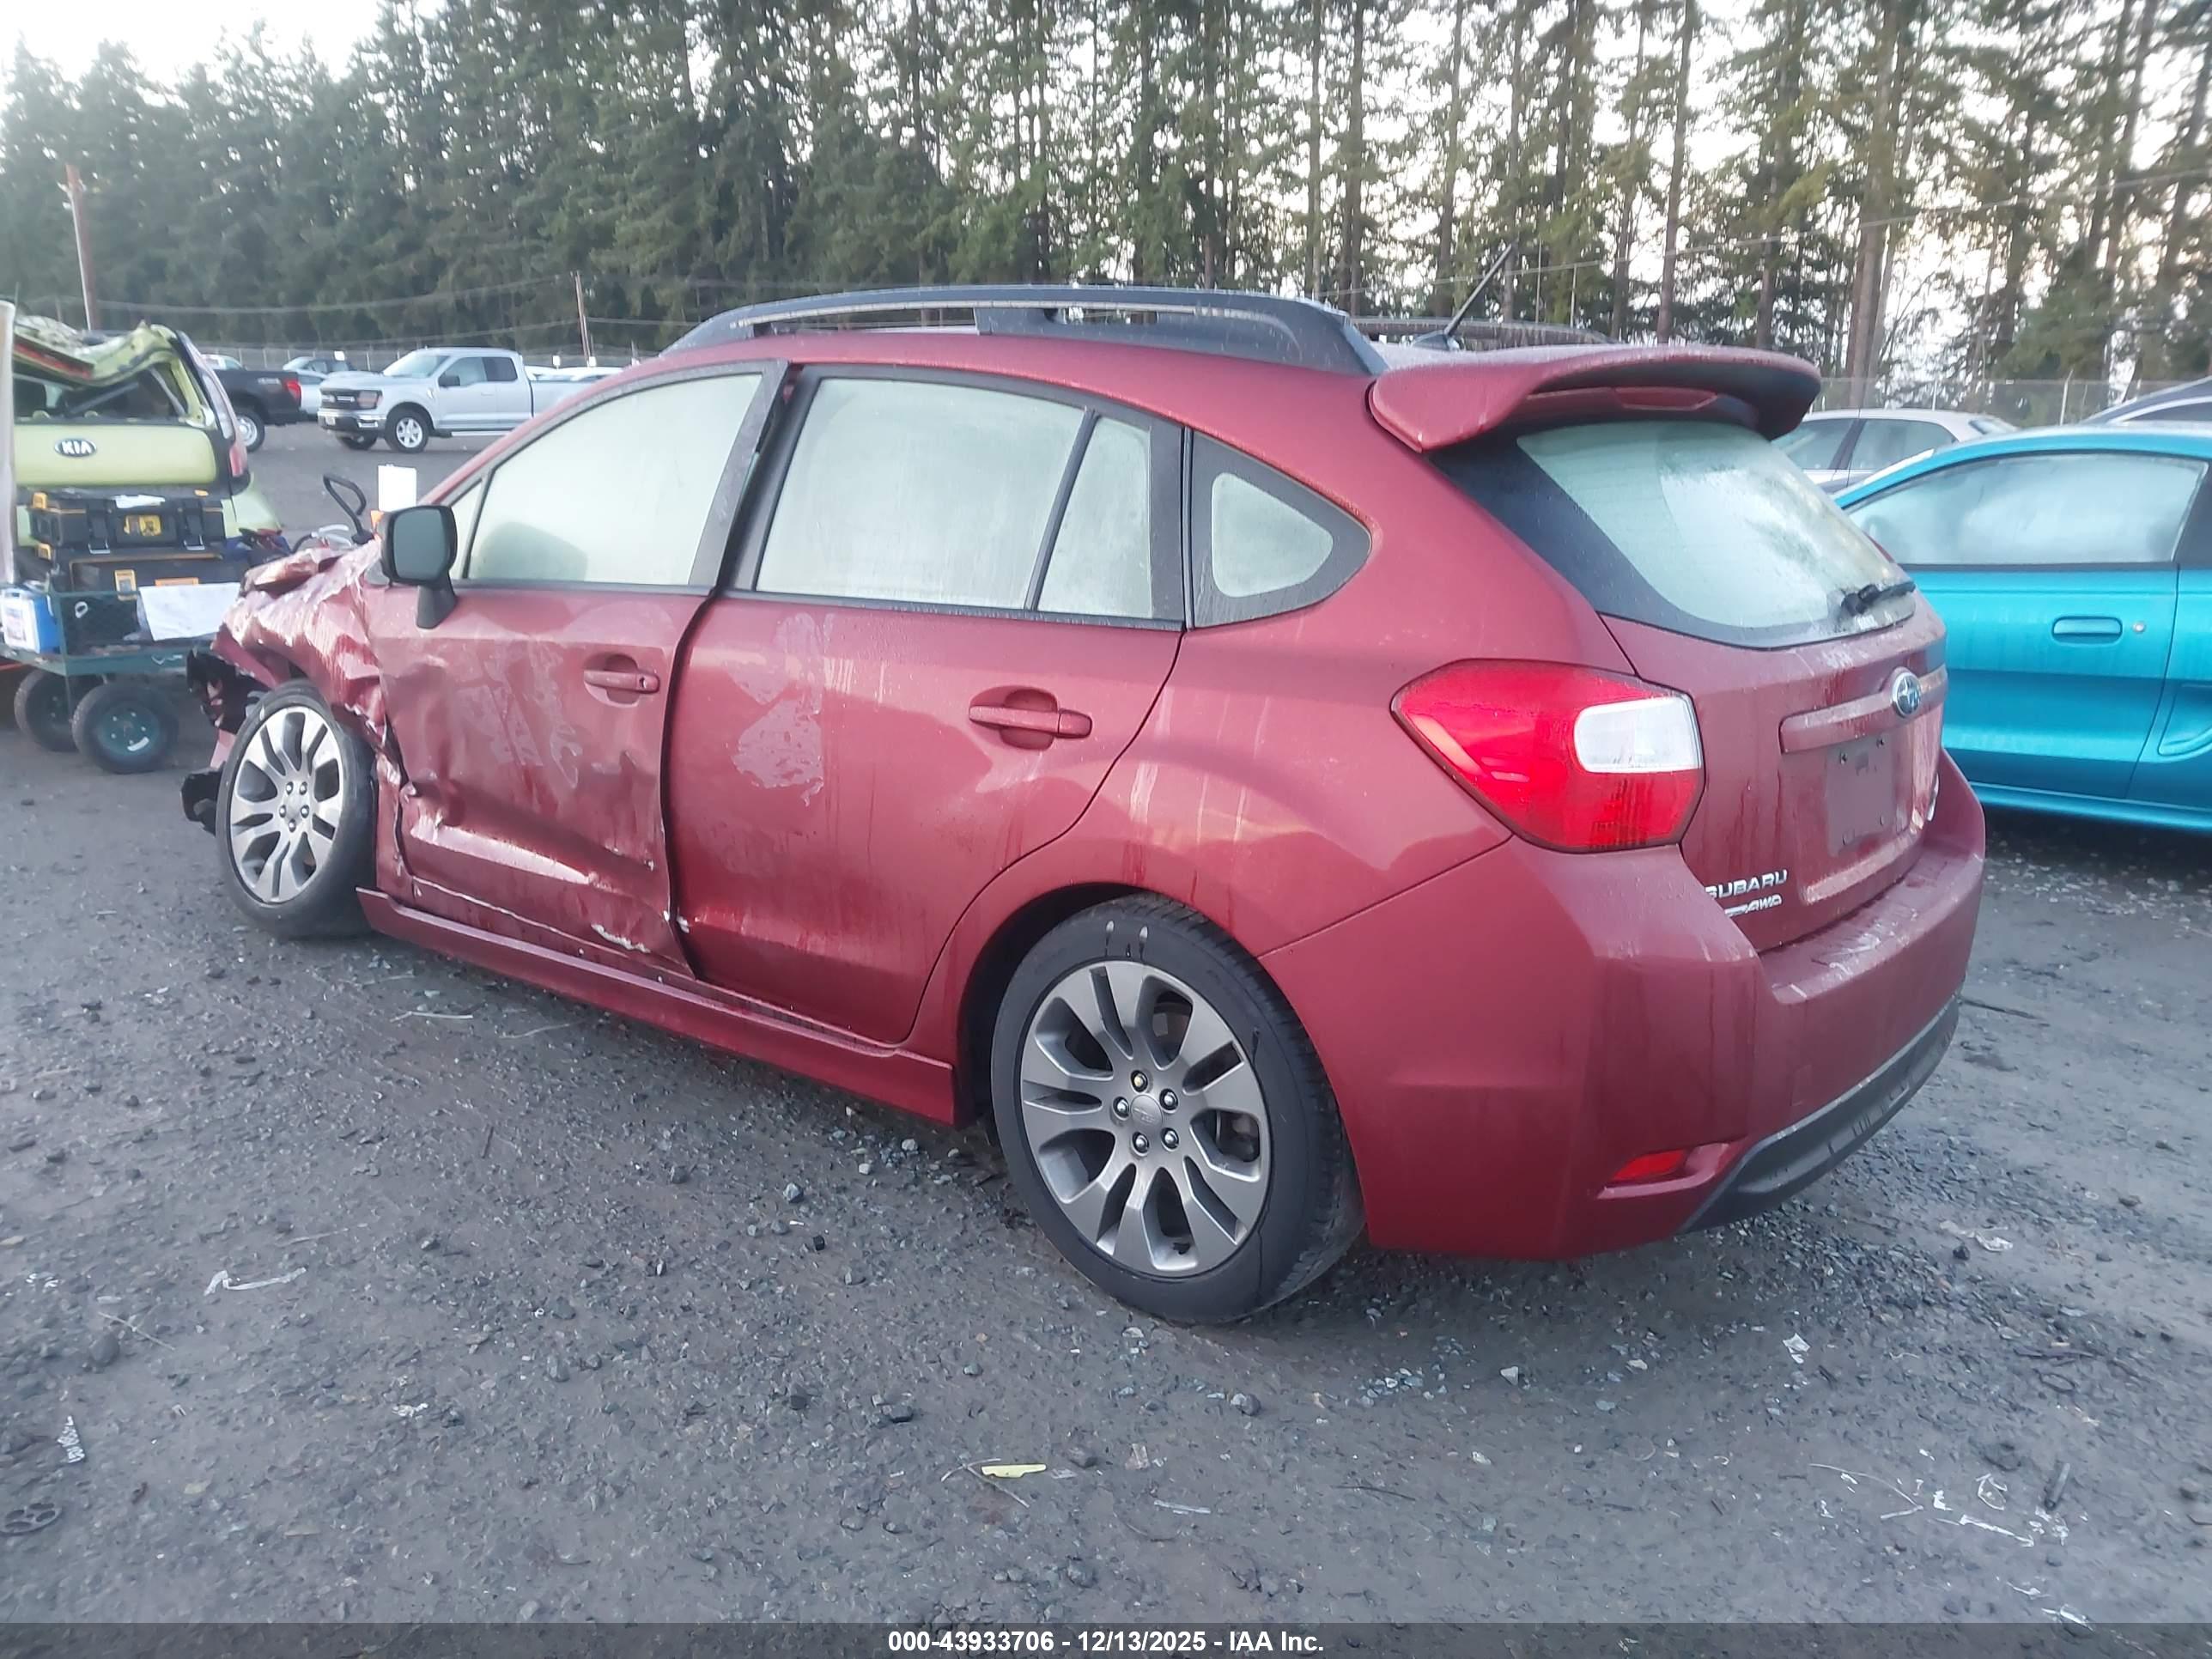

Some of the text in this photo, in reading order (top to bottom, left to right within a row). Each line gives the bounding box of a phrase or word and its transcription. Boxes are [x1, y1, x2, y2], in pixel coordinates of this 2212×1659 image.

[61, 440, 92, 454] KIA
[1705, 869, 1788, 898] SUBARU
[1745, 894, 1782, 914] AWD
